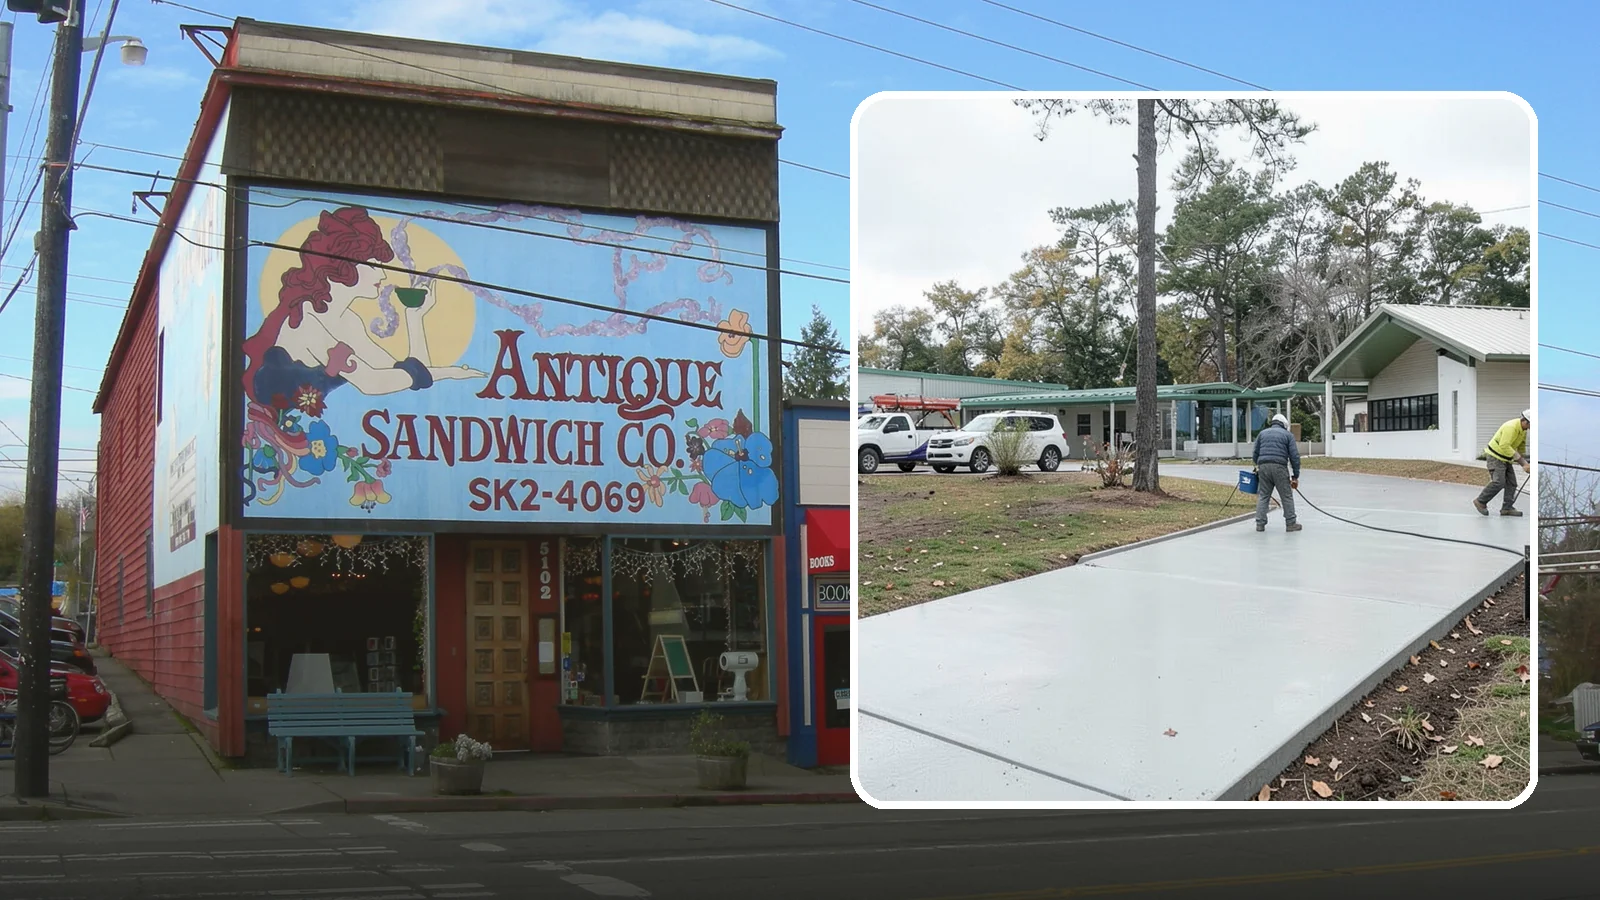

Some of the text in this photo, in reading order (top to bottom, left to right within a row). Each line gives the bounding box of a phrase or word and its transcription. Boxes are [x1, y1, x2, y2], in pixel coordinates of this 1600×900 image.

[475, 329, 723, 419] ANTIQUE
[361, 408, 685, 469] SANDWICH CO.
[469, 477, 646, 513] SK2-4069
[539, 542, 551, 599] 5102
[809, 555, 835, 569] BOOKS
